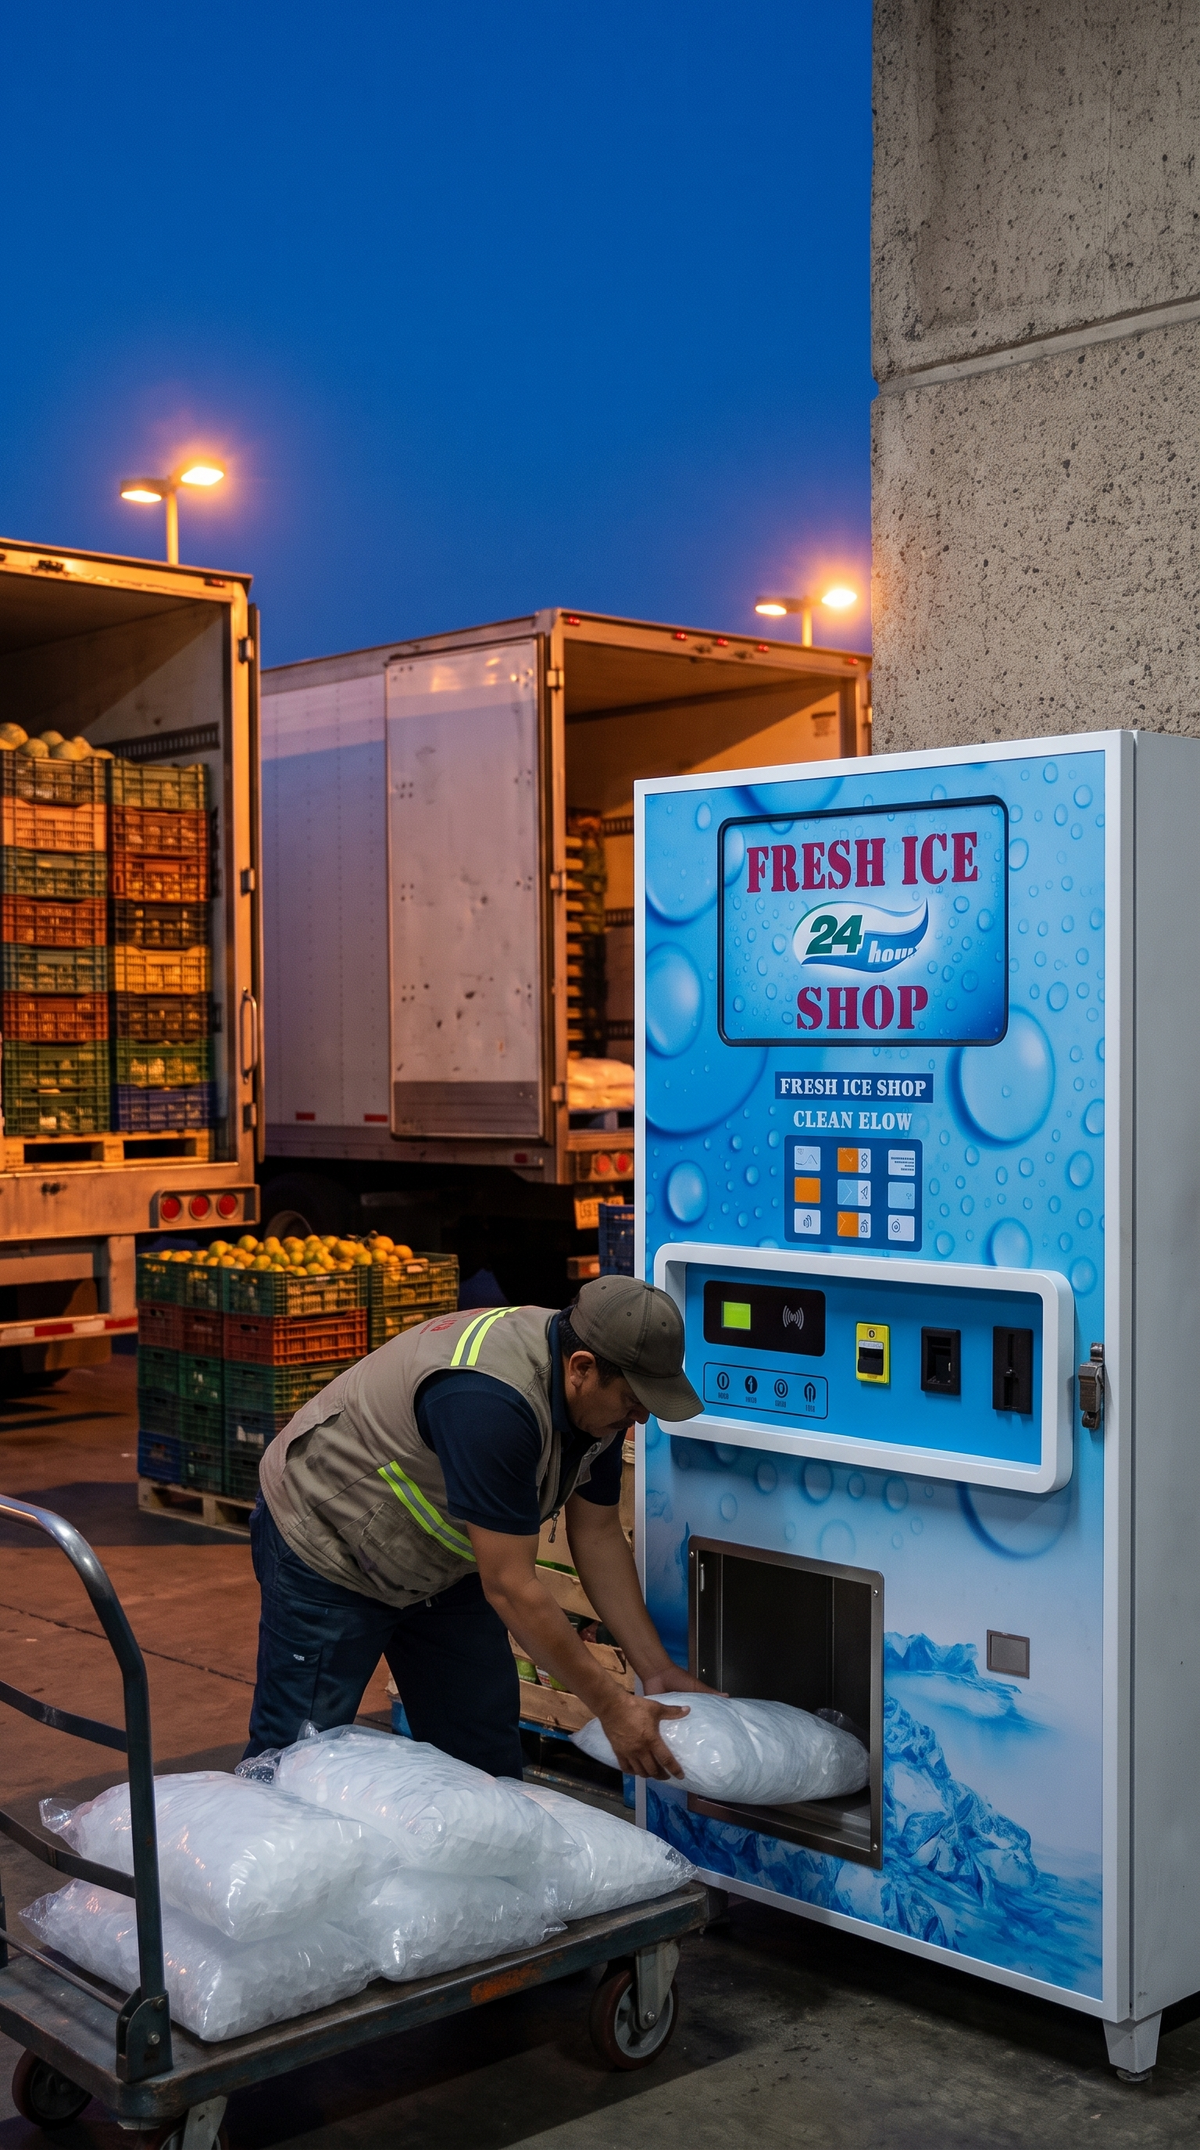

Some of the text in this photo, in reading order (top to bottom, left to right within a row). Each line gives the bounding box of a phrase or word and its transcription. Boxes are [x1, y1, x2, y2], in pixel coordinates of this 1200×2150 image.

[746, 831, 978, 893] FRESH ICE
[805, 914, 863, 955] 24
[797, 985, 928, 1030] SHOP
[780, 1078, 927, 1097] FRESH ICE SHOP
[793, 1110, 913, 1131] CLEAN ELOW
